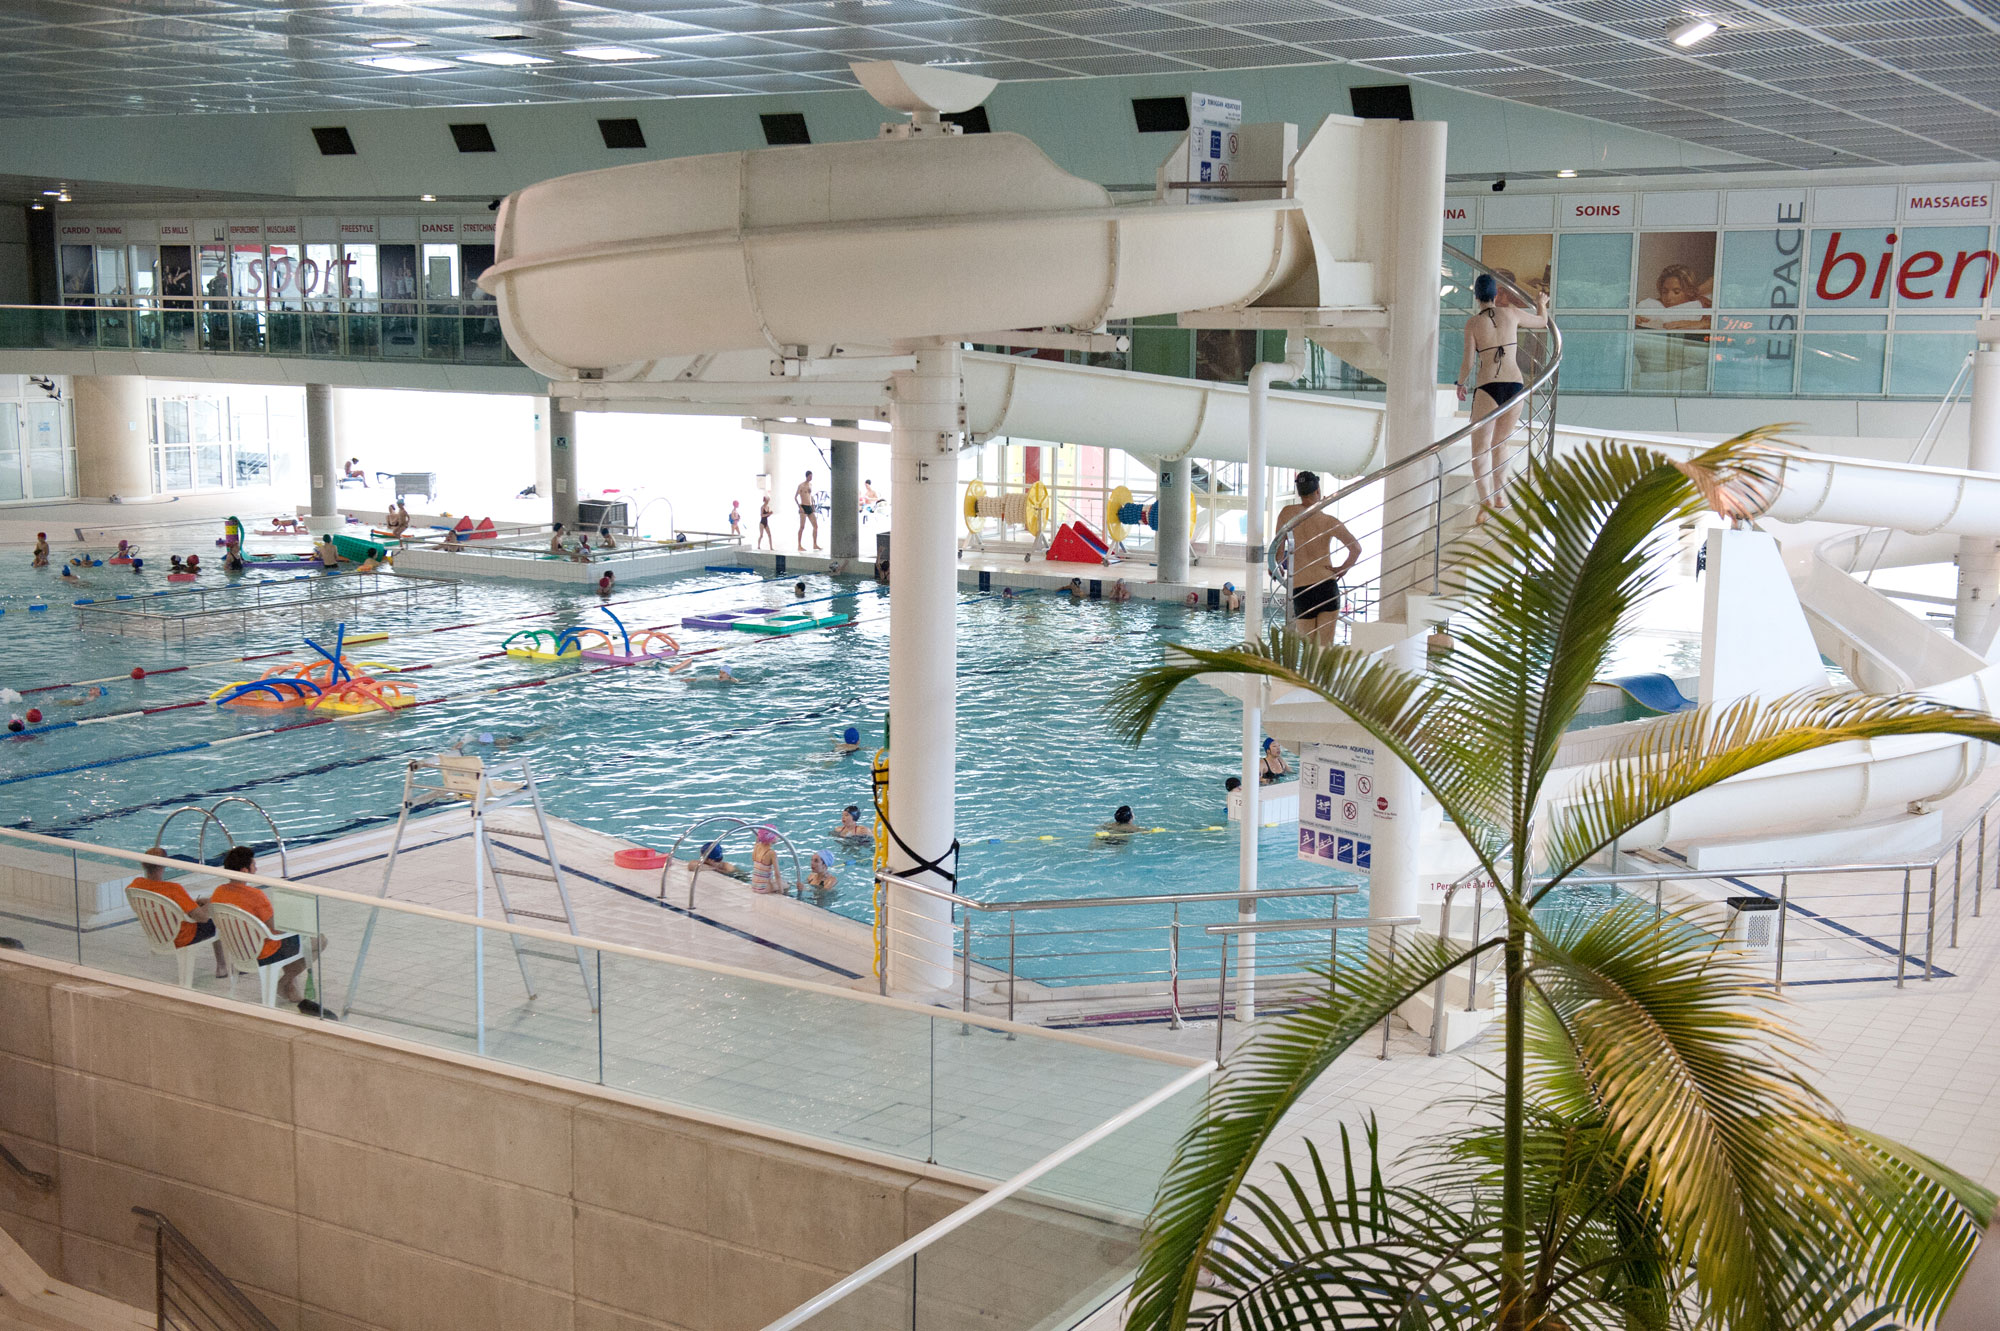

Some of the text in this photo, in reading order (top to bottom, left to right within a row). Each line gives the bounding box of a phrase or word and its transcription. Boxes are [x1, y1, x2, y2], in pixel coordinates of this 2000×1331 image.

[1910, 195, 1988, 209] MASSAGES
[1443, 208, 1466, 219] NA
[1575, 205, 1621, 217] SOINS
[341, 225, 373, 233] FREESTYLE
[422, 224, 454, 233] DANSE
[1816, 232, 2000, 301] bien
[247, 252, 357, 307] sport
[1766, 201, 1803, 360] ESPACE
